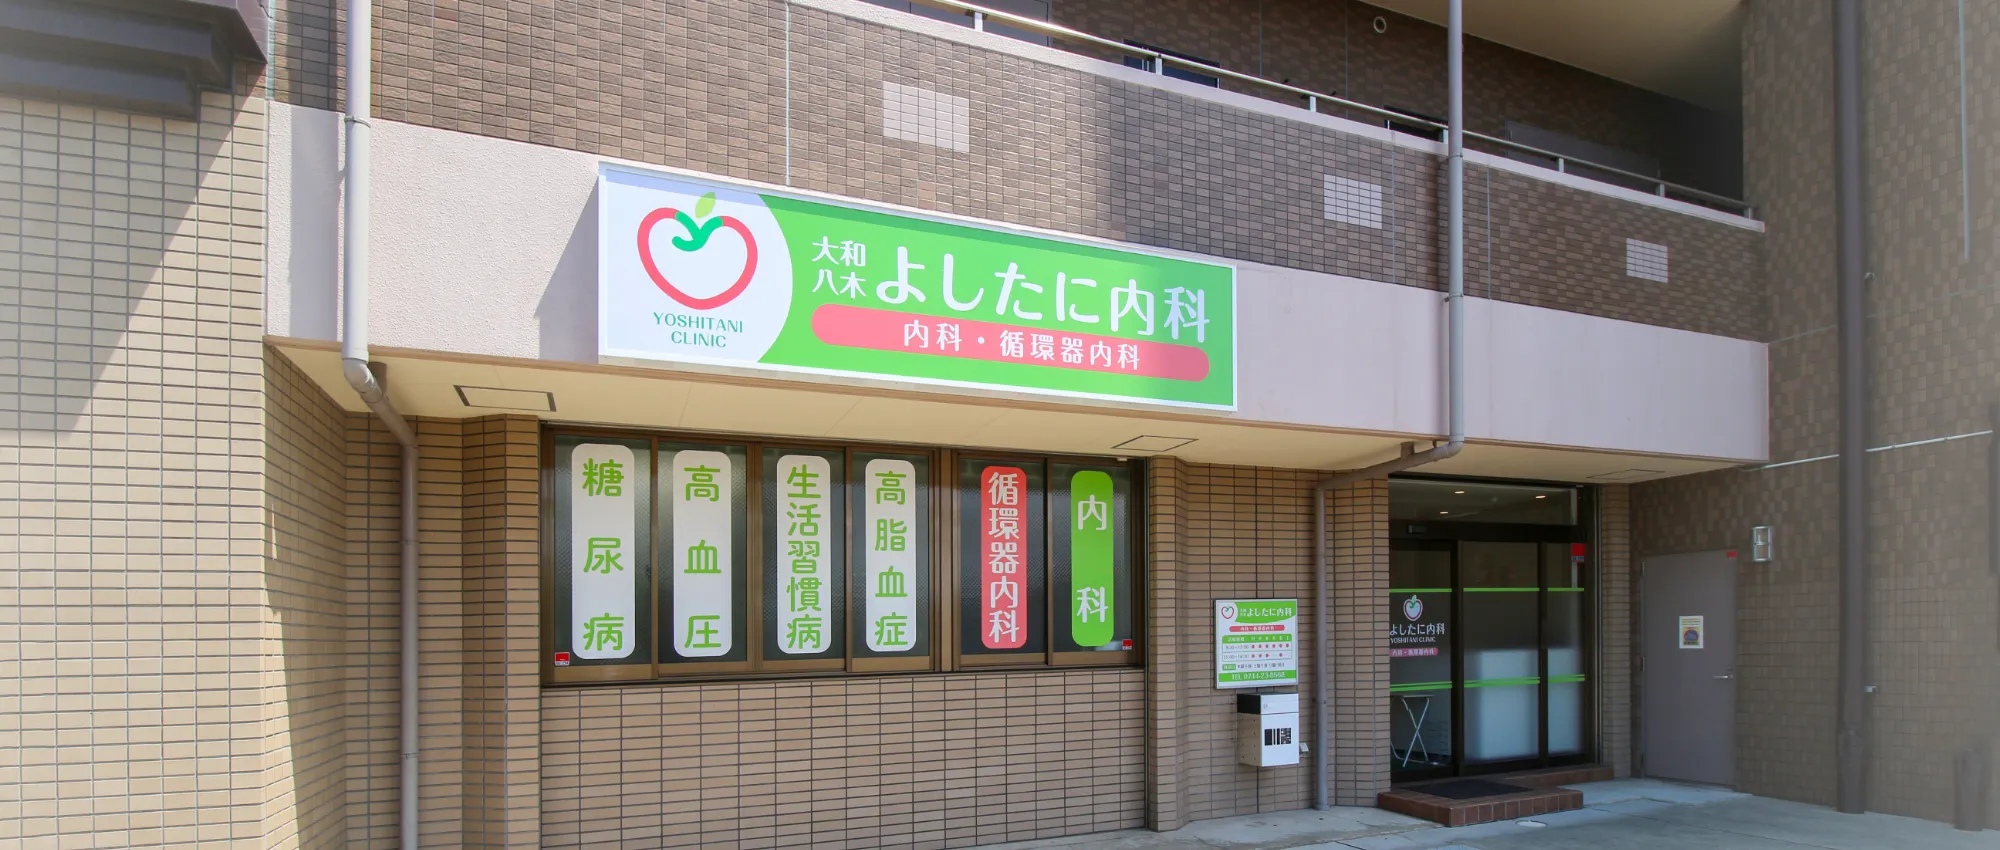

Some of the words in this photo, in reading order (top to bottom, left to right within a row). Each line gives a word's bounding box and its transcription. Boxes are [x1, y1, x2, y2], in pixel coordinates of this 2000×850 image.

[812, 235, 866, 267] 大和
[812, 266, 866, 299] 八木
[877, 246, 1210, 343] よしたに内科
[653, 311, 744, 333] YOSHITANI
[671, 330, 727, 349] CLINIC
[582, 459, 625, 651] 糖尿病
[683, 465, 722, 650] 高血圧
[786, 465, 822, 650] 生活習慣病
[874, 470, 909, 647] 高脂血症
[988, 471, 1020, 643] 循環器内科
[1076, 494, 1108, 623] 内科
[1389, 622, 1445, 636] よしたに内科
